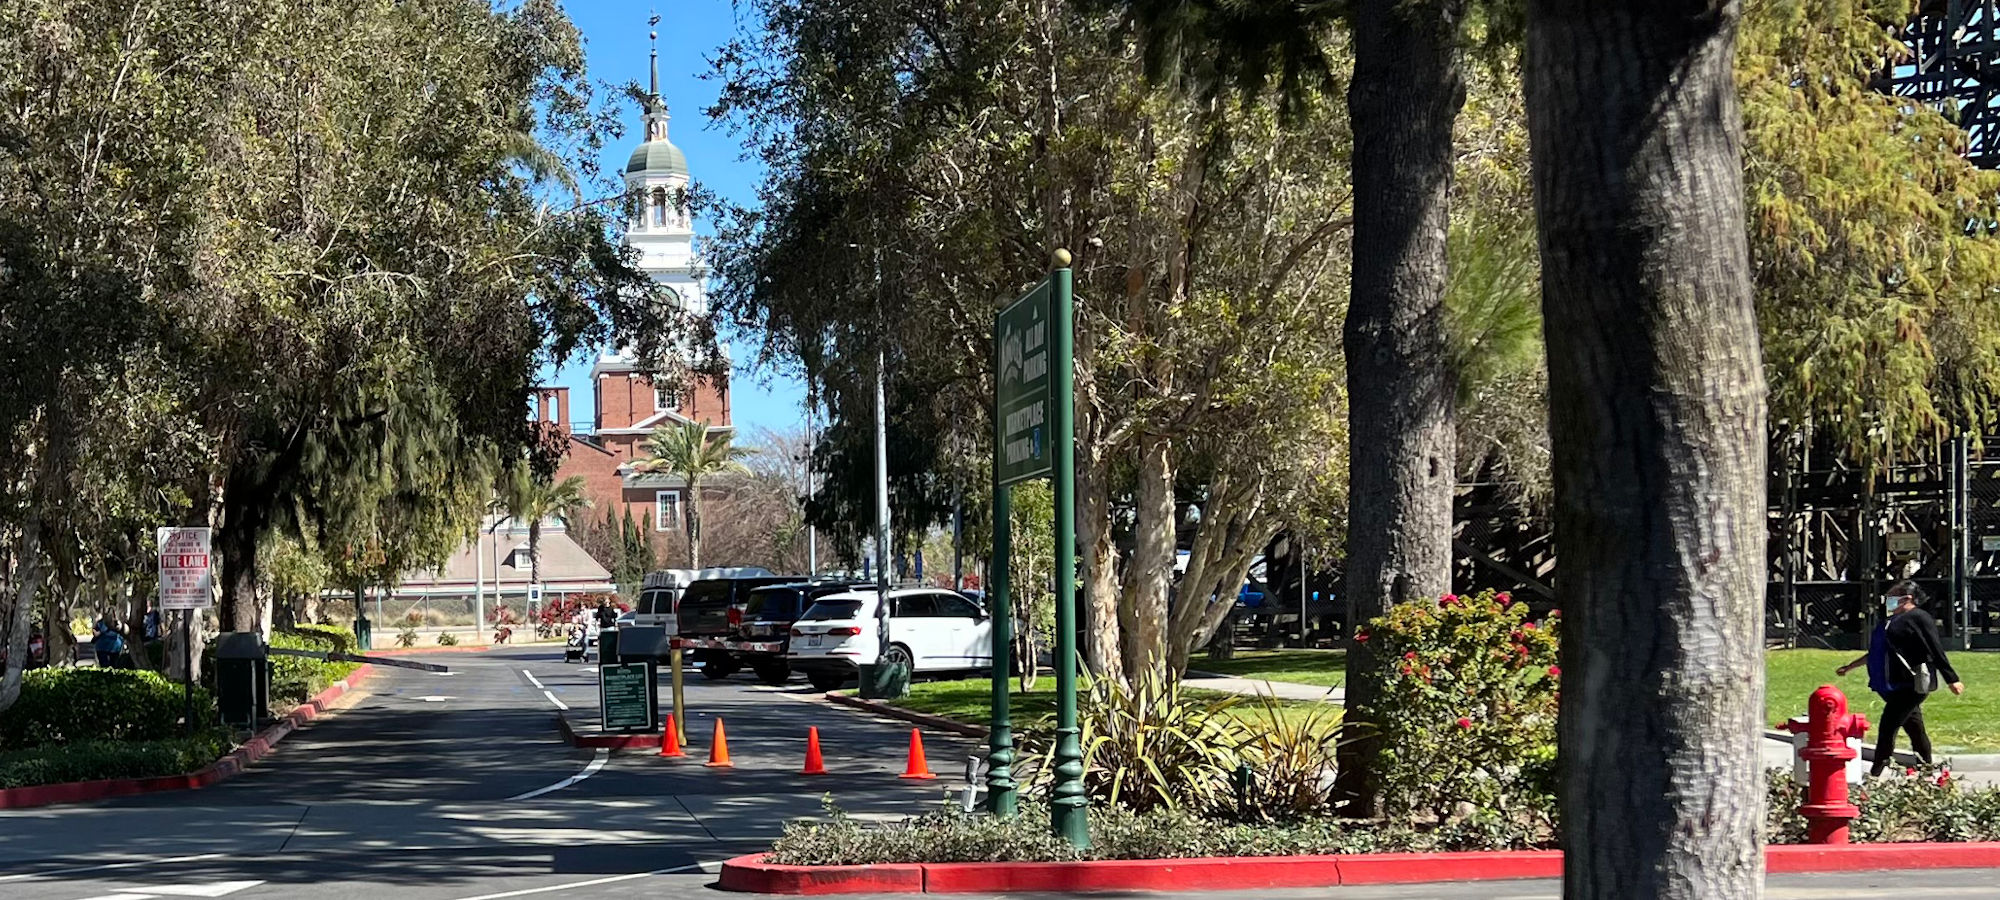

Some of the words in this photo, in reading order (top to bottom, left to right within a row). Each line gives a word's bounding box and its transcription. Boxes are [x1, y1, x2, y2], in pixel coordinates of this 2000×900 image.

[1023, 350, 1047, 384] PARKING
[1006, 400, 1044, 437] MARKETPLACE
[1006, 437, 1030, 465] PARKING
[164, 556, 182, 567] FIRE
[183, 556, 206, 567] LANE
